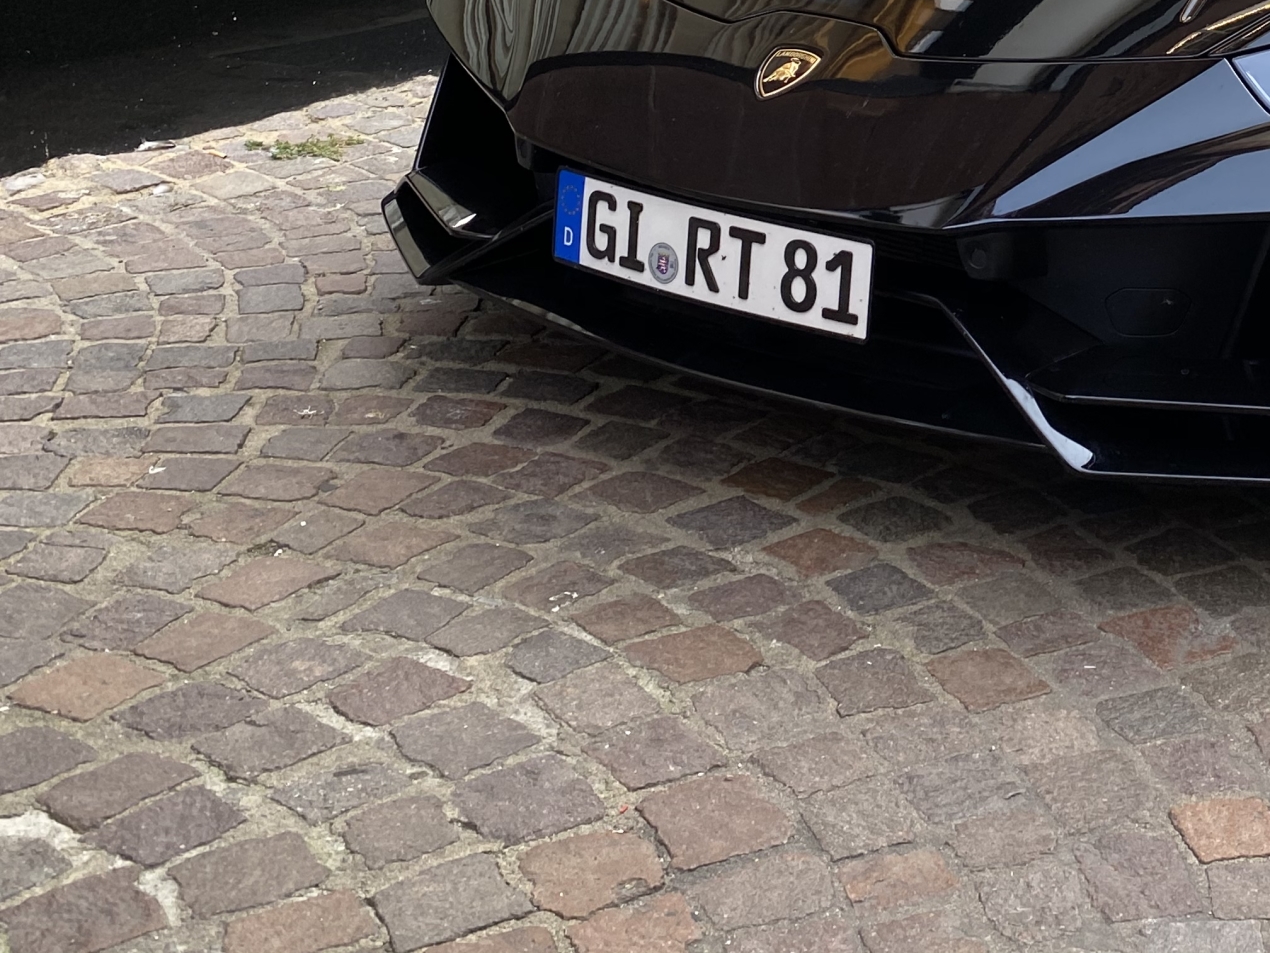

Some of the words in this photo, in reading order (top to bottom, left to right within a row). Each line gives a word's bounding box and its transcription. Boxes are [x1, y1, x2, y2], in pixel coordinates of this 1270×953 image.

[563, 226, 574, 246] D
[586, 190, 645, 273] GI
[684, 216, 767, 300] RT
[780, 239, 859, 325] 81
